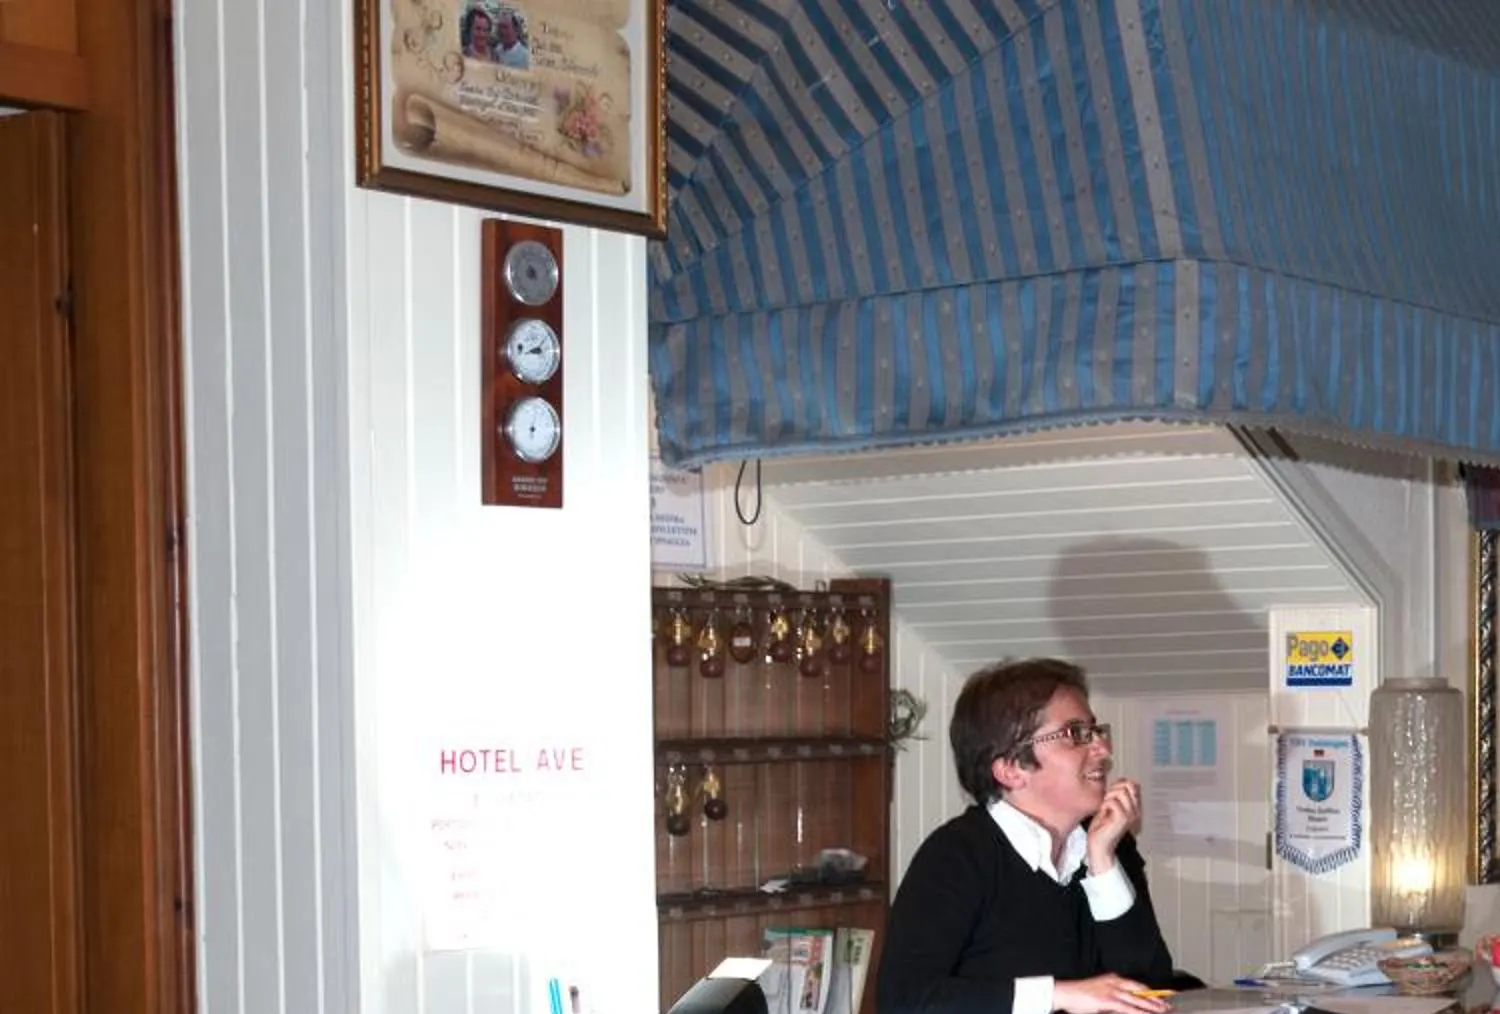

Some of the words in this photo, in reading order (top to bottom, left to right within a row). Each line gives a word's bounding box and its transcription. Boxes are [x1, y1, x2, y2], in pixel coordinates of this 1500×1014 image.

[1286, 632, 1329, 662] Pago
[1288, 665, 1349, 677] BANCOMAT
[441, 749, 521, 775] HOTEL
[537, 748, 584, 771] AVE
